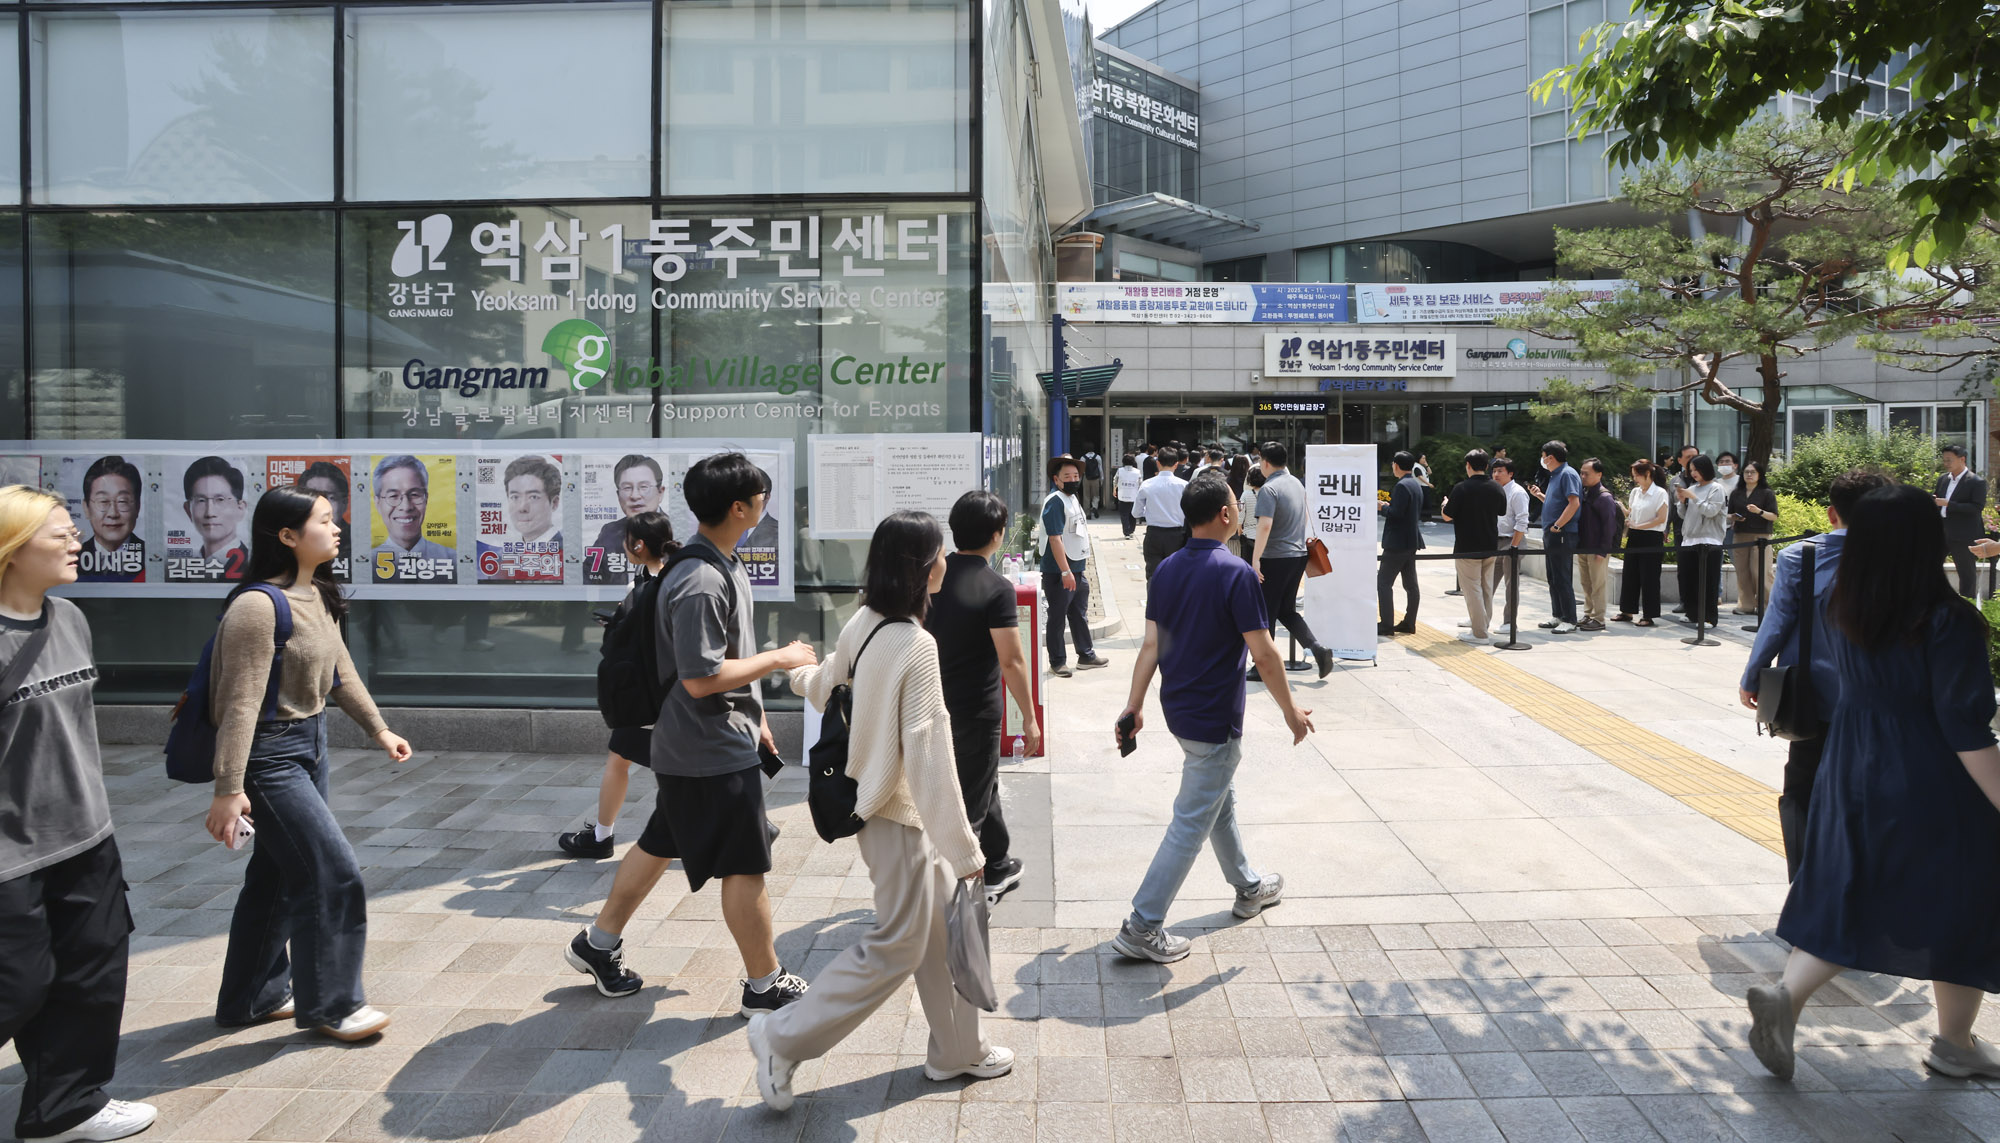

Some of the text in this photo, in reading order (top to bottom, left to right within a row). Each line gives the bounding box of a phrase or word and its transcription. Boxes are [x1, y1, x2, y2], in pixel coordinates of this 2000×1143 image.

[1103, 107, 1124, 123] 1-dong
[1124, 115, 1154, 135] Community
[1155, 127, 1175, 141] Cultural
[1176, 135, 1197, 149] Complex
[470, 214, 948, 282] 역삼1동주민센터
[388, 282, 456, 306] 강남구
[1151, 287, 1183, 297] 분리배출
[1185, 287, 1201, 297] 거점
[1389, 295, 1411, 306] 세탁
[1412, 294, 1424, 306] 및
[1425, 294, 1436, 306] 짐
[1439, 294, 1460, 306] 보관
[1462, 293, 1494, 305] 서비스
[471, 286, 945, 314] Yeoksam 1-dong Community Service Center
[1096, 300, 1137, 310] 재활용품을
[1139, 300, 1187, 310] 종량제봉투로
[1215, 301, 1248, 311] 드립니다
[1307, 340, 1445, 361] 역삼1동주민센터
[1466, 348, 1508, 361] Gangnam
[1279, 360, 1303, 369] 강남구
[1309, 363, 1444, 372] Yeoksam 1-dong Community Service Center
[403, 358, 548, 398] Gangnam
[704, 355, 821, 395] Village
[830, 355, 946, 386] Center
[1392, 380, 1408, 391] 16
[663, 402, 746, 422] Support
[754, 402, 824, 419] Center
[832, 400, 860, 417] for
[869, 400, 941, 419] Expats
[1259, 403, 1325, 411] 365 무인민원발급창구
[270, 460, 306, 474] 미래를
[270, 475, 294, 487] 여는
[1318, 474, 1361, 496] 관내
[480, 510, 502, 522] 정치
[1317, 505, 1361, 521] 선거인
[481, 523, 507, 535] 교체!
[1321, 522, 1356, 533] [강남구]
[122, 543, 142, 551] 지금은
[80, 551, 142, 573] 이재명
[168, 548, 245, 579] 김문수 2
[479, 551, 562, 577] 6 구주와
[585, 546, 604, 573] 7
[752, 552, 776, 561] 해결사
[332, 557, 349, 579] 석
[375, 551, 454, 580] 5 권영국
